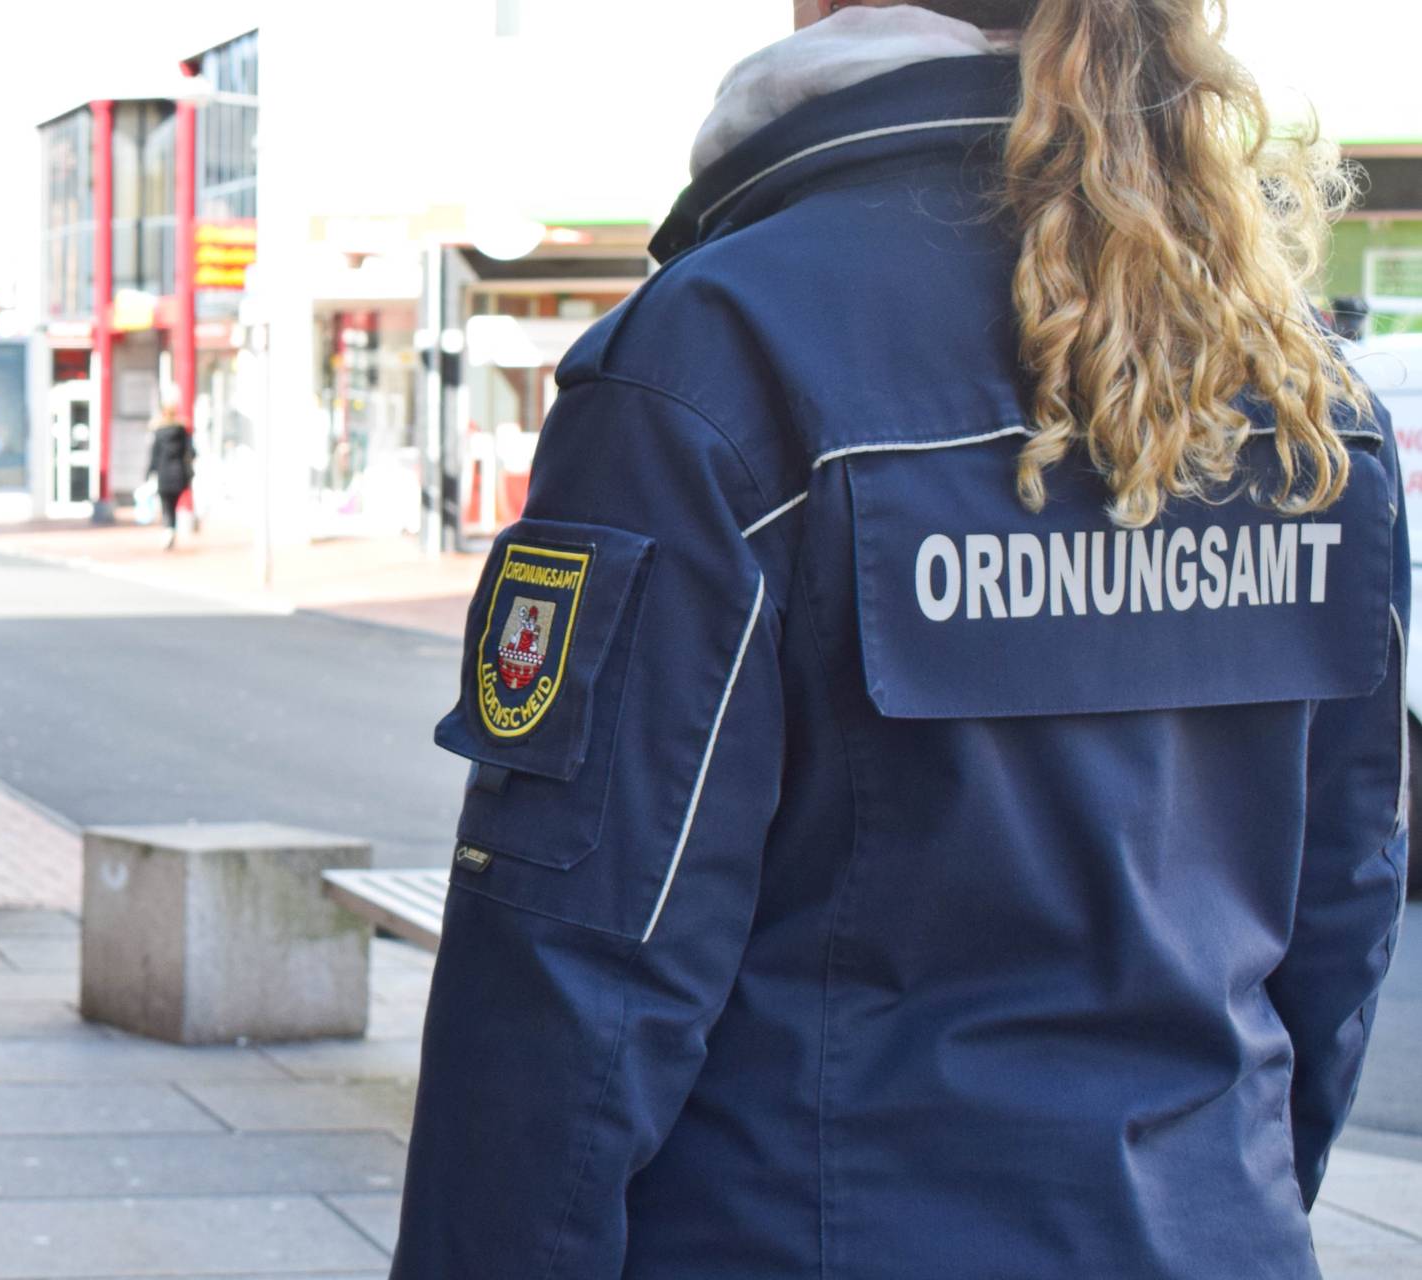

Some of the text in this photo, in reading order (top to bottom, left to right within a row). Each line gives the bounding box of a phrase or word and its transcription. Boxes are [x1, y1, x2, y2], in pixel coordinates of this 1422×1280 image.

[505, 559, 580, 590] ORDNUNGSAMT
[915, 523, 1343, 622] ORDNUNGSAMT
[481, 662, 553, 728] LÜDENSCHEID
